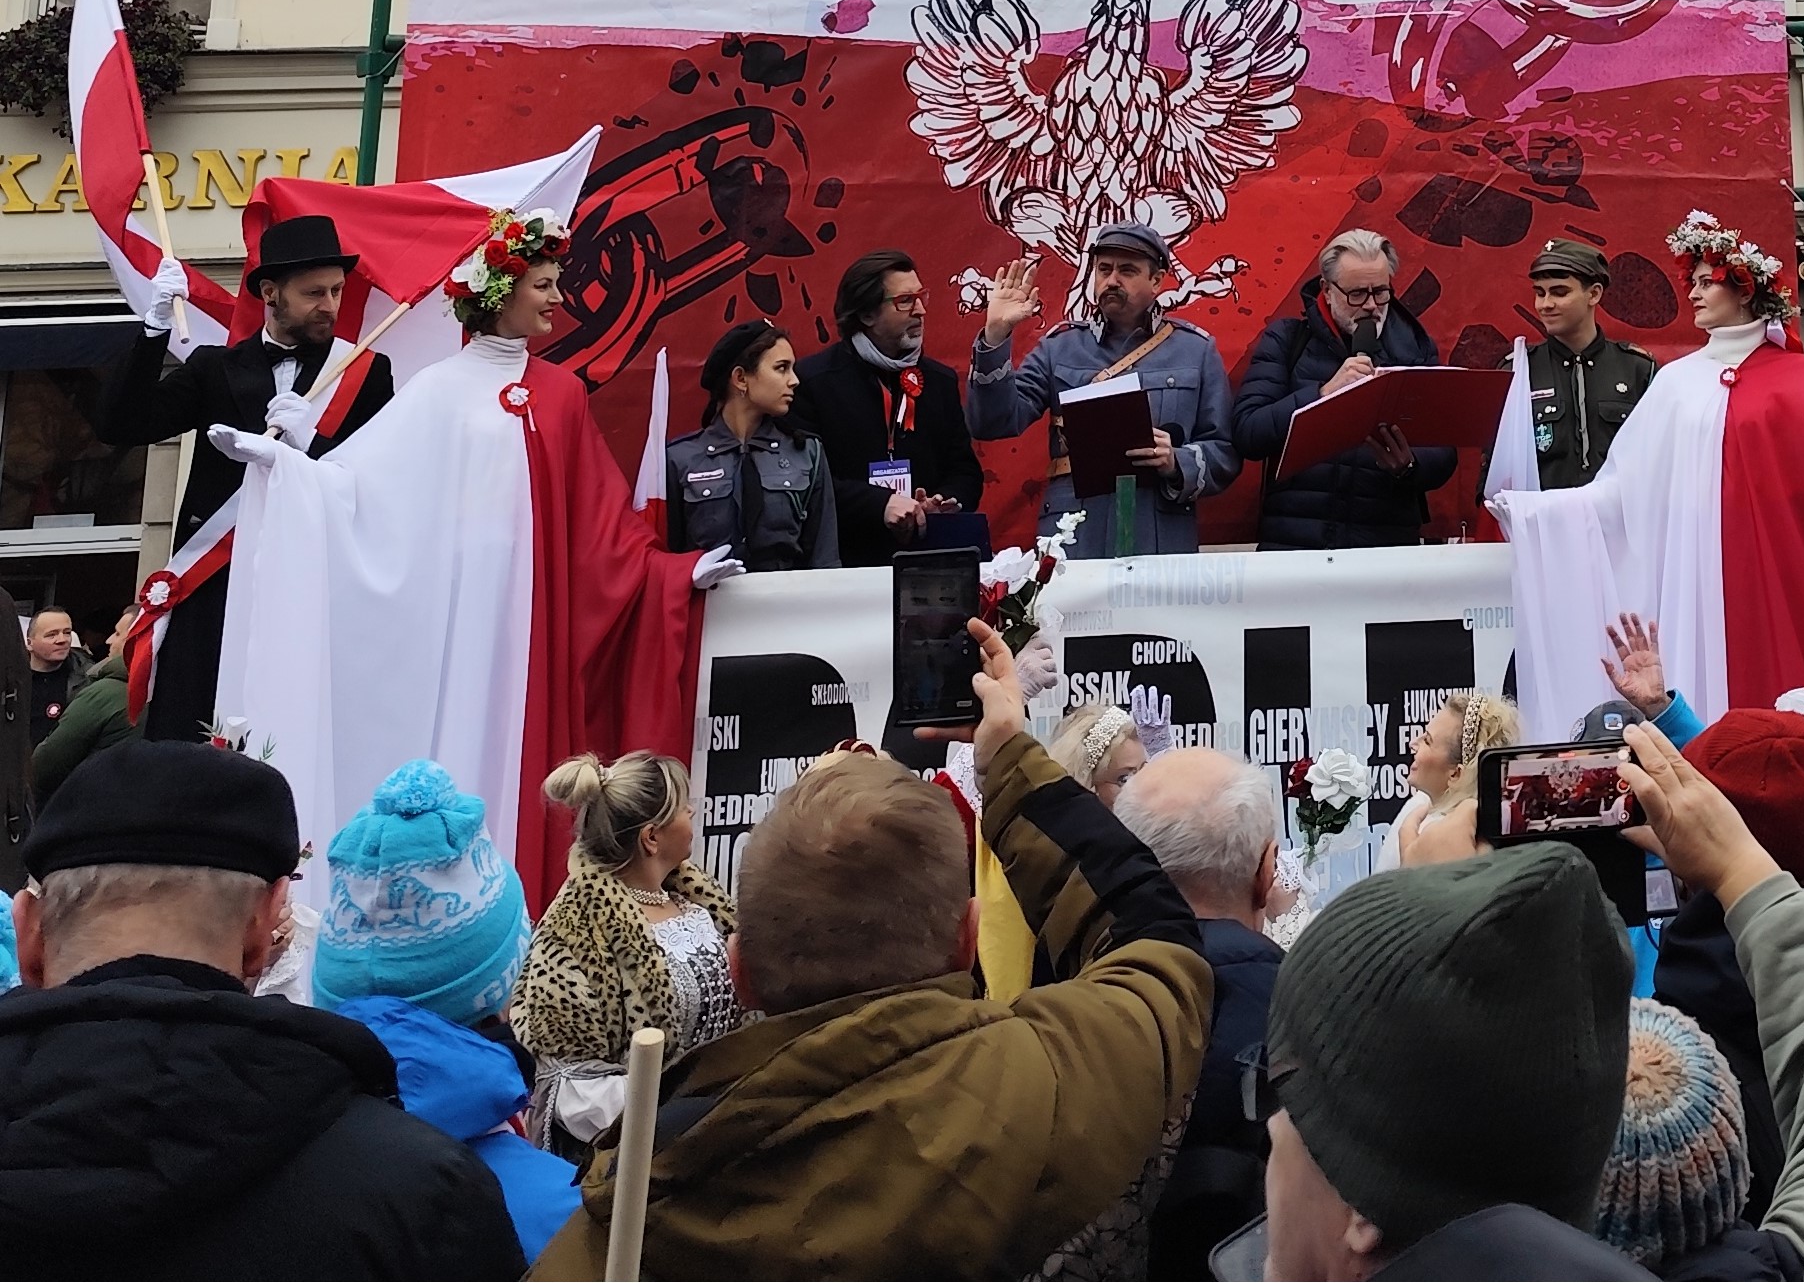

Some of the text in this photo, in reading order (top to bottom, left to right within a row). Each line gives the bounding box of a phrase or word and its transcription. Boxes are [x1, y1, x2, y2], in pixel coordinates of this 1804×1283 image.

[1107, 557, 1247, 608] GIERYMSCY
[1131, 640, 1193, 665] CHOPIN
[811, 682, 871, 706] SKŁODOWSKA
